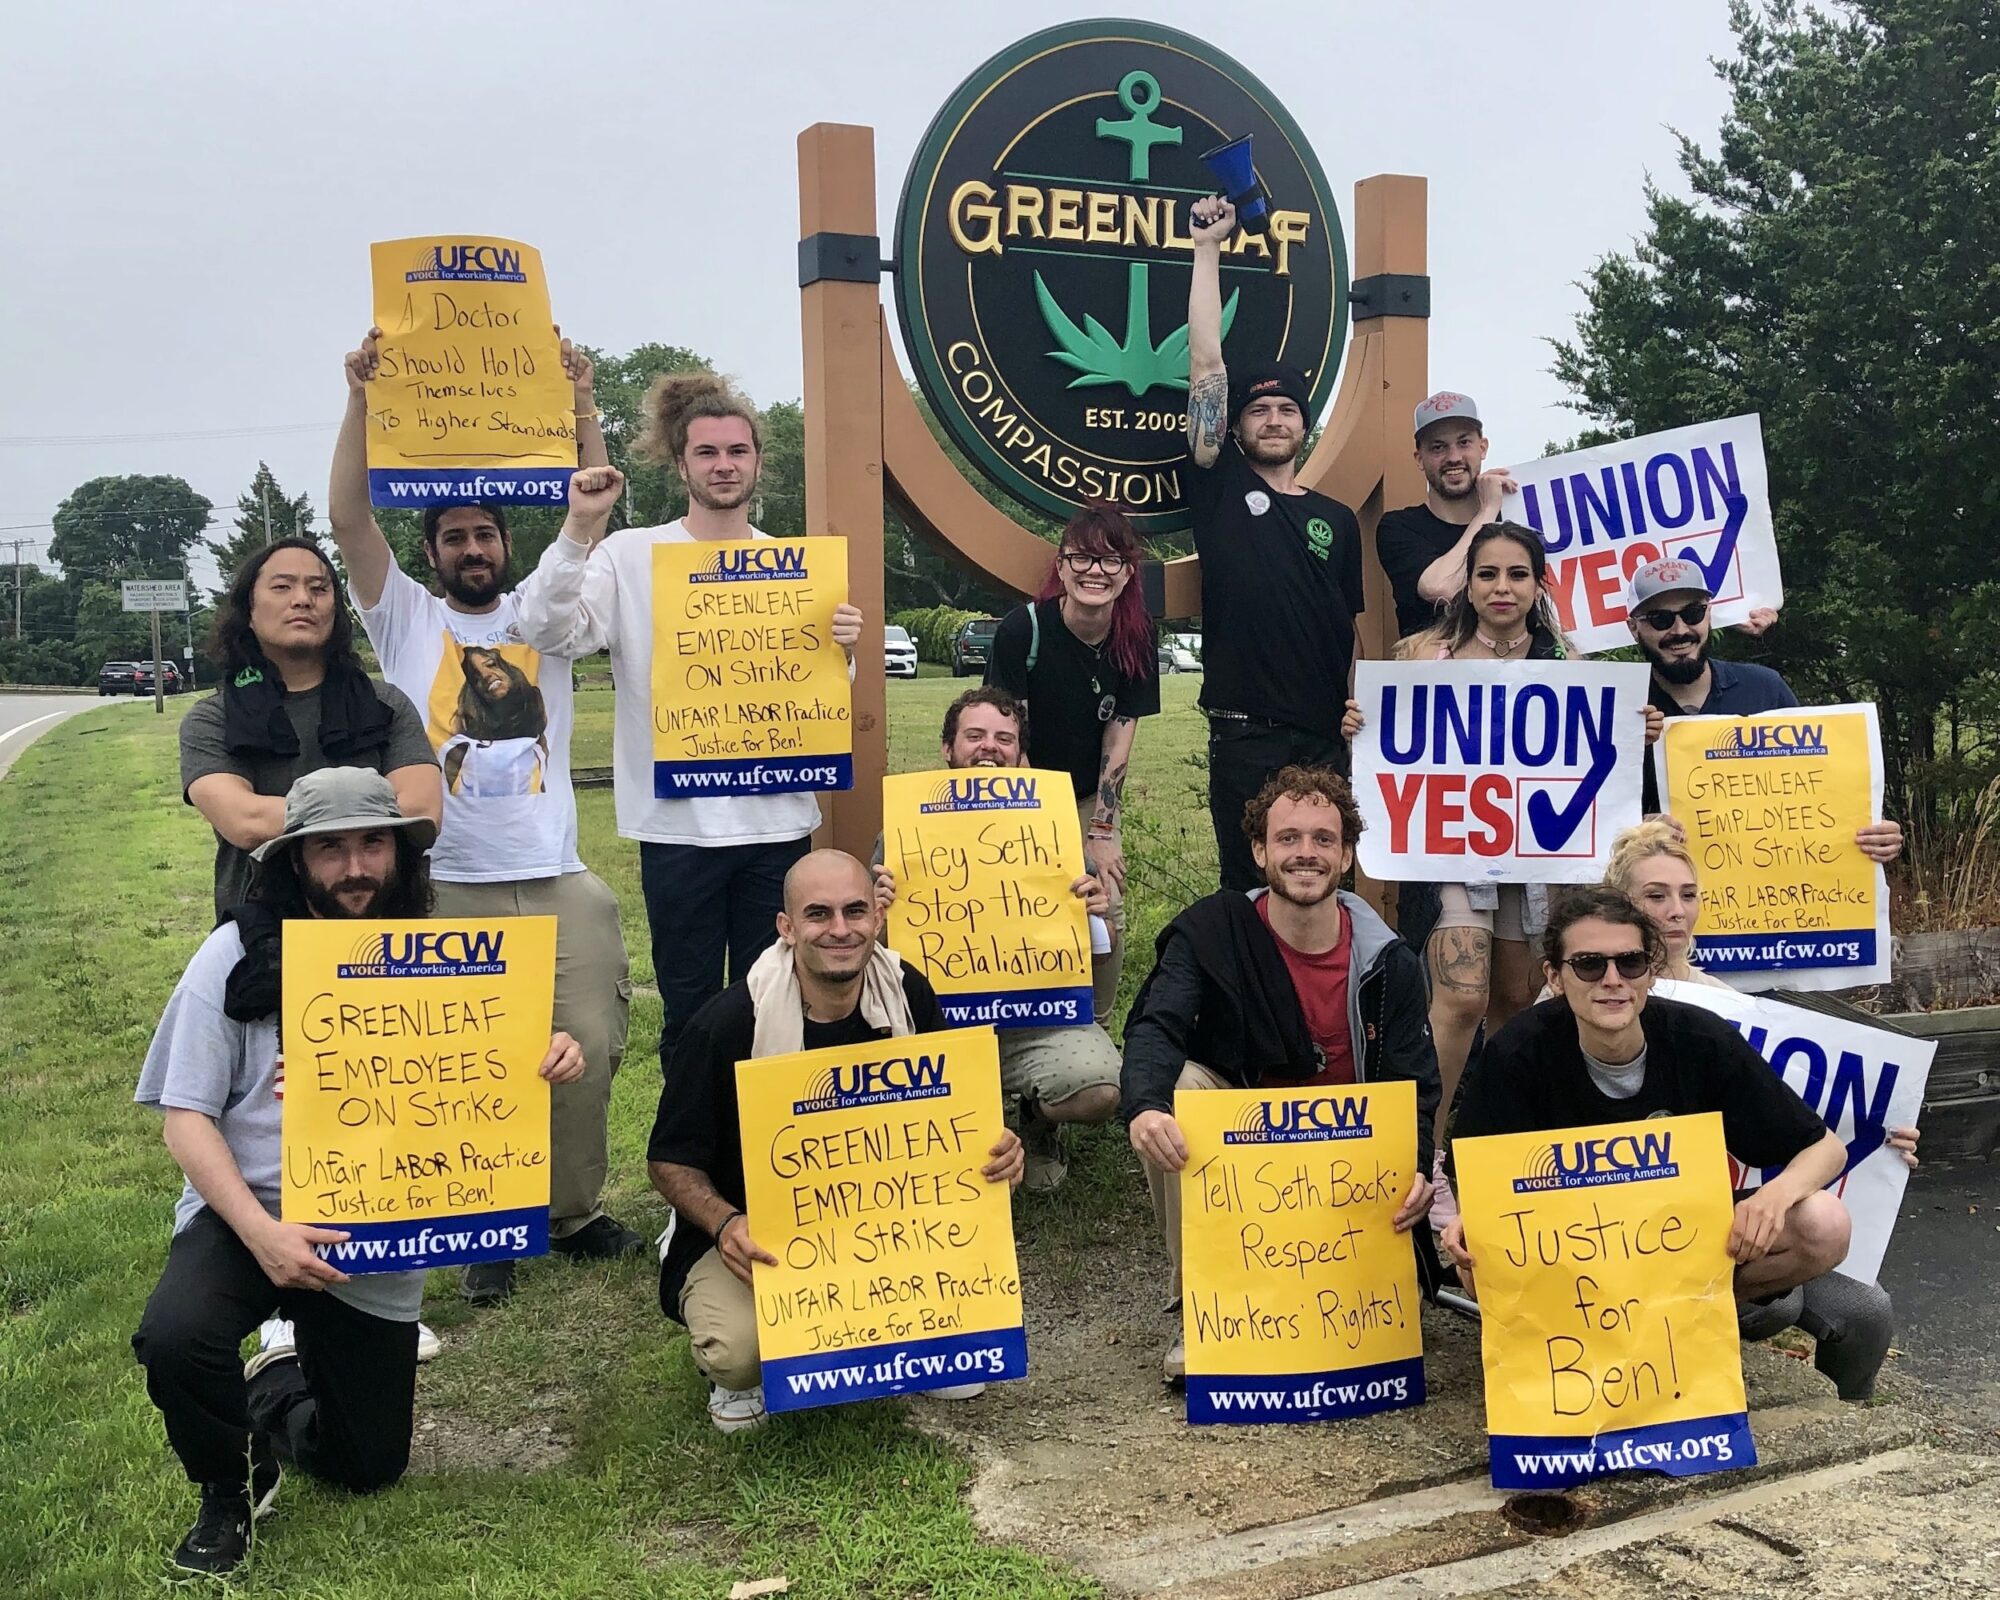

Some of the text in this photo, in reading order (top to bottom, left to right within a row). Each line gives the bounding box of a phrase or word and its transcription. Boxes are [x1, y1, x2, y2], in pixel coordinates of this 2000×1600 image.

[948, 180, 1310, 277] GREENLAF
[413, 271, 439, 280] VOICE
[441, 271, 454, 279] for
[457, 271, 492, 280] working
[493, 272, 525, 282] America
[434, 246, 521, 272] UFCW
[398, 292, 522, 330] A Doctor
[380, 345, 535, 378] Should Hold
[405, 381, 517, 400] Themselves
[375, 408, 576, 441] To Higher Standards
[947, 339, 1180, 504] COMPASSION
[1085, 407, 1187, 432] EST. 2009
[388, 476, 563, 499] www.ufcw.org
[1521, 441, 1742, 554] UNION
[697, 573, 723, 582] VOICE
[738, 572, 771, 580] working
[772, 571, 806, 579] America
[719, 547, 805, 572] UFCW
[685, 588, 813, 619] GREENLEAF
[677, 624, 819, 656] EMPLOYEES
[686, 656, 812, 690] ON Strike
[725, 703, 781, 724] LABOR
[785, 698, 850, 722] Practice
[1380, 684, 1617, 767] UNION
[682, 726, 803, 757] Justice for Ben!
[1713, 749, 1741, 758] VOICE
[1742, 748, 1755, 756] for
[1757, 748, 1791, 756] working
[1792, 746, 1826, 754] America
[1734, 724, 1823, 748] UFCW
[672, 766, 838, 788] www.ufcw.org
[949, 777, 1036, 802] UFCW
[1687, 766, 1824, 799] GREENLEAF
[928, 804, 954, 812] VOICE
[957, 802, 970, 810] for
[971, 802, 1005, 810] working
[1006, 800, 1040, 808] America
[1376, 773, 1514, 857] YES
[1696, 802, 1836, 838] EMPLOYEES
[897, 820, 1062, 892] Hey Seth!
[1704, 836, 1842, 870] ON Strike
[907, 880, 1059, 933] Stop the
[1748, 885, 1799, 908] LABOR
[1802, 879, 1870, 905] Practice
[1707, 905, 1831, 930] Justice for Ben!
[381, 931, 504, 964] UFCW
[919, 925, 1086, 979] Retaliation!
[1696, 940, 1860, 961] www.ufcw.org
[340, 962, 504, 976] a VOICE for working America
[301, 993, 506, 1043] GREENLEAF
[315, 1049, 507, 1091] EMPLOYEES
[832, 1053, 945, 1096] UFCW
[338, 1096, 396, 1127] ON
[804, 1097, 839, 1112] VOICE
[841, 1095, 857, 1107] for
[859, 1091, 902, 1104] working
[904, 1085, 948, 1099] America
[1260, 1096, 1368, 1131] UFCW
[771, 1111, 978, 1179] GREENLEAF
[1233, 1132, 1268, 1142] VOICE
[1270, 1130, 1286, 1141] for
[1288, 1130, 1329, 1141] working
[1331, 1127, 1370, 1138] America
[380, 1148, 452, 1181] LABOR
[461, 1142, 547, 1174] Practice
[1551, 1132, 1672, 1175] UFCW
[1192, 1155, 1397, 1213] Tell Seth Bock:
[1516, 1165, 1676, 1190] a VOICE for working America
[317, 1174, 495, 1217] Justice for Ben!
[793, 1168, 981, 1227] EMPLOYEES
[312, 1224, 529, 1260] www.ufcw.org
[786, 1228, 837, 1270] ON
[1240, 1219, 1363, 1280] Respect
[1499, 1201, 1698, 1267] Justice
[852, 1275, 927, 1311] LABOR
[936, 1263, 1020, 1301] Practice
[1574, 1275, 1639, 1332] for
[805, 1303, 963, 1351] Justice for Ben!
[1191, 1283, 1405, 1350] Workers' Rights!
[786, 1346, 1005, 1394] www.ufcw.org
[1546, 1316, 1681, 1416] Ben!
[1208, 1376, 1408, 1411] www.ufcw.org
[1514, 1433, 1733, 1475] www.ufcw.org
